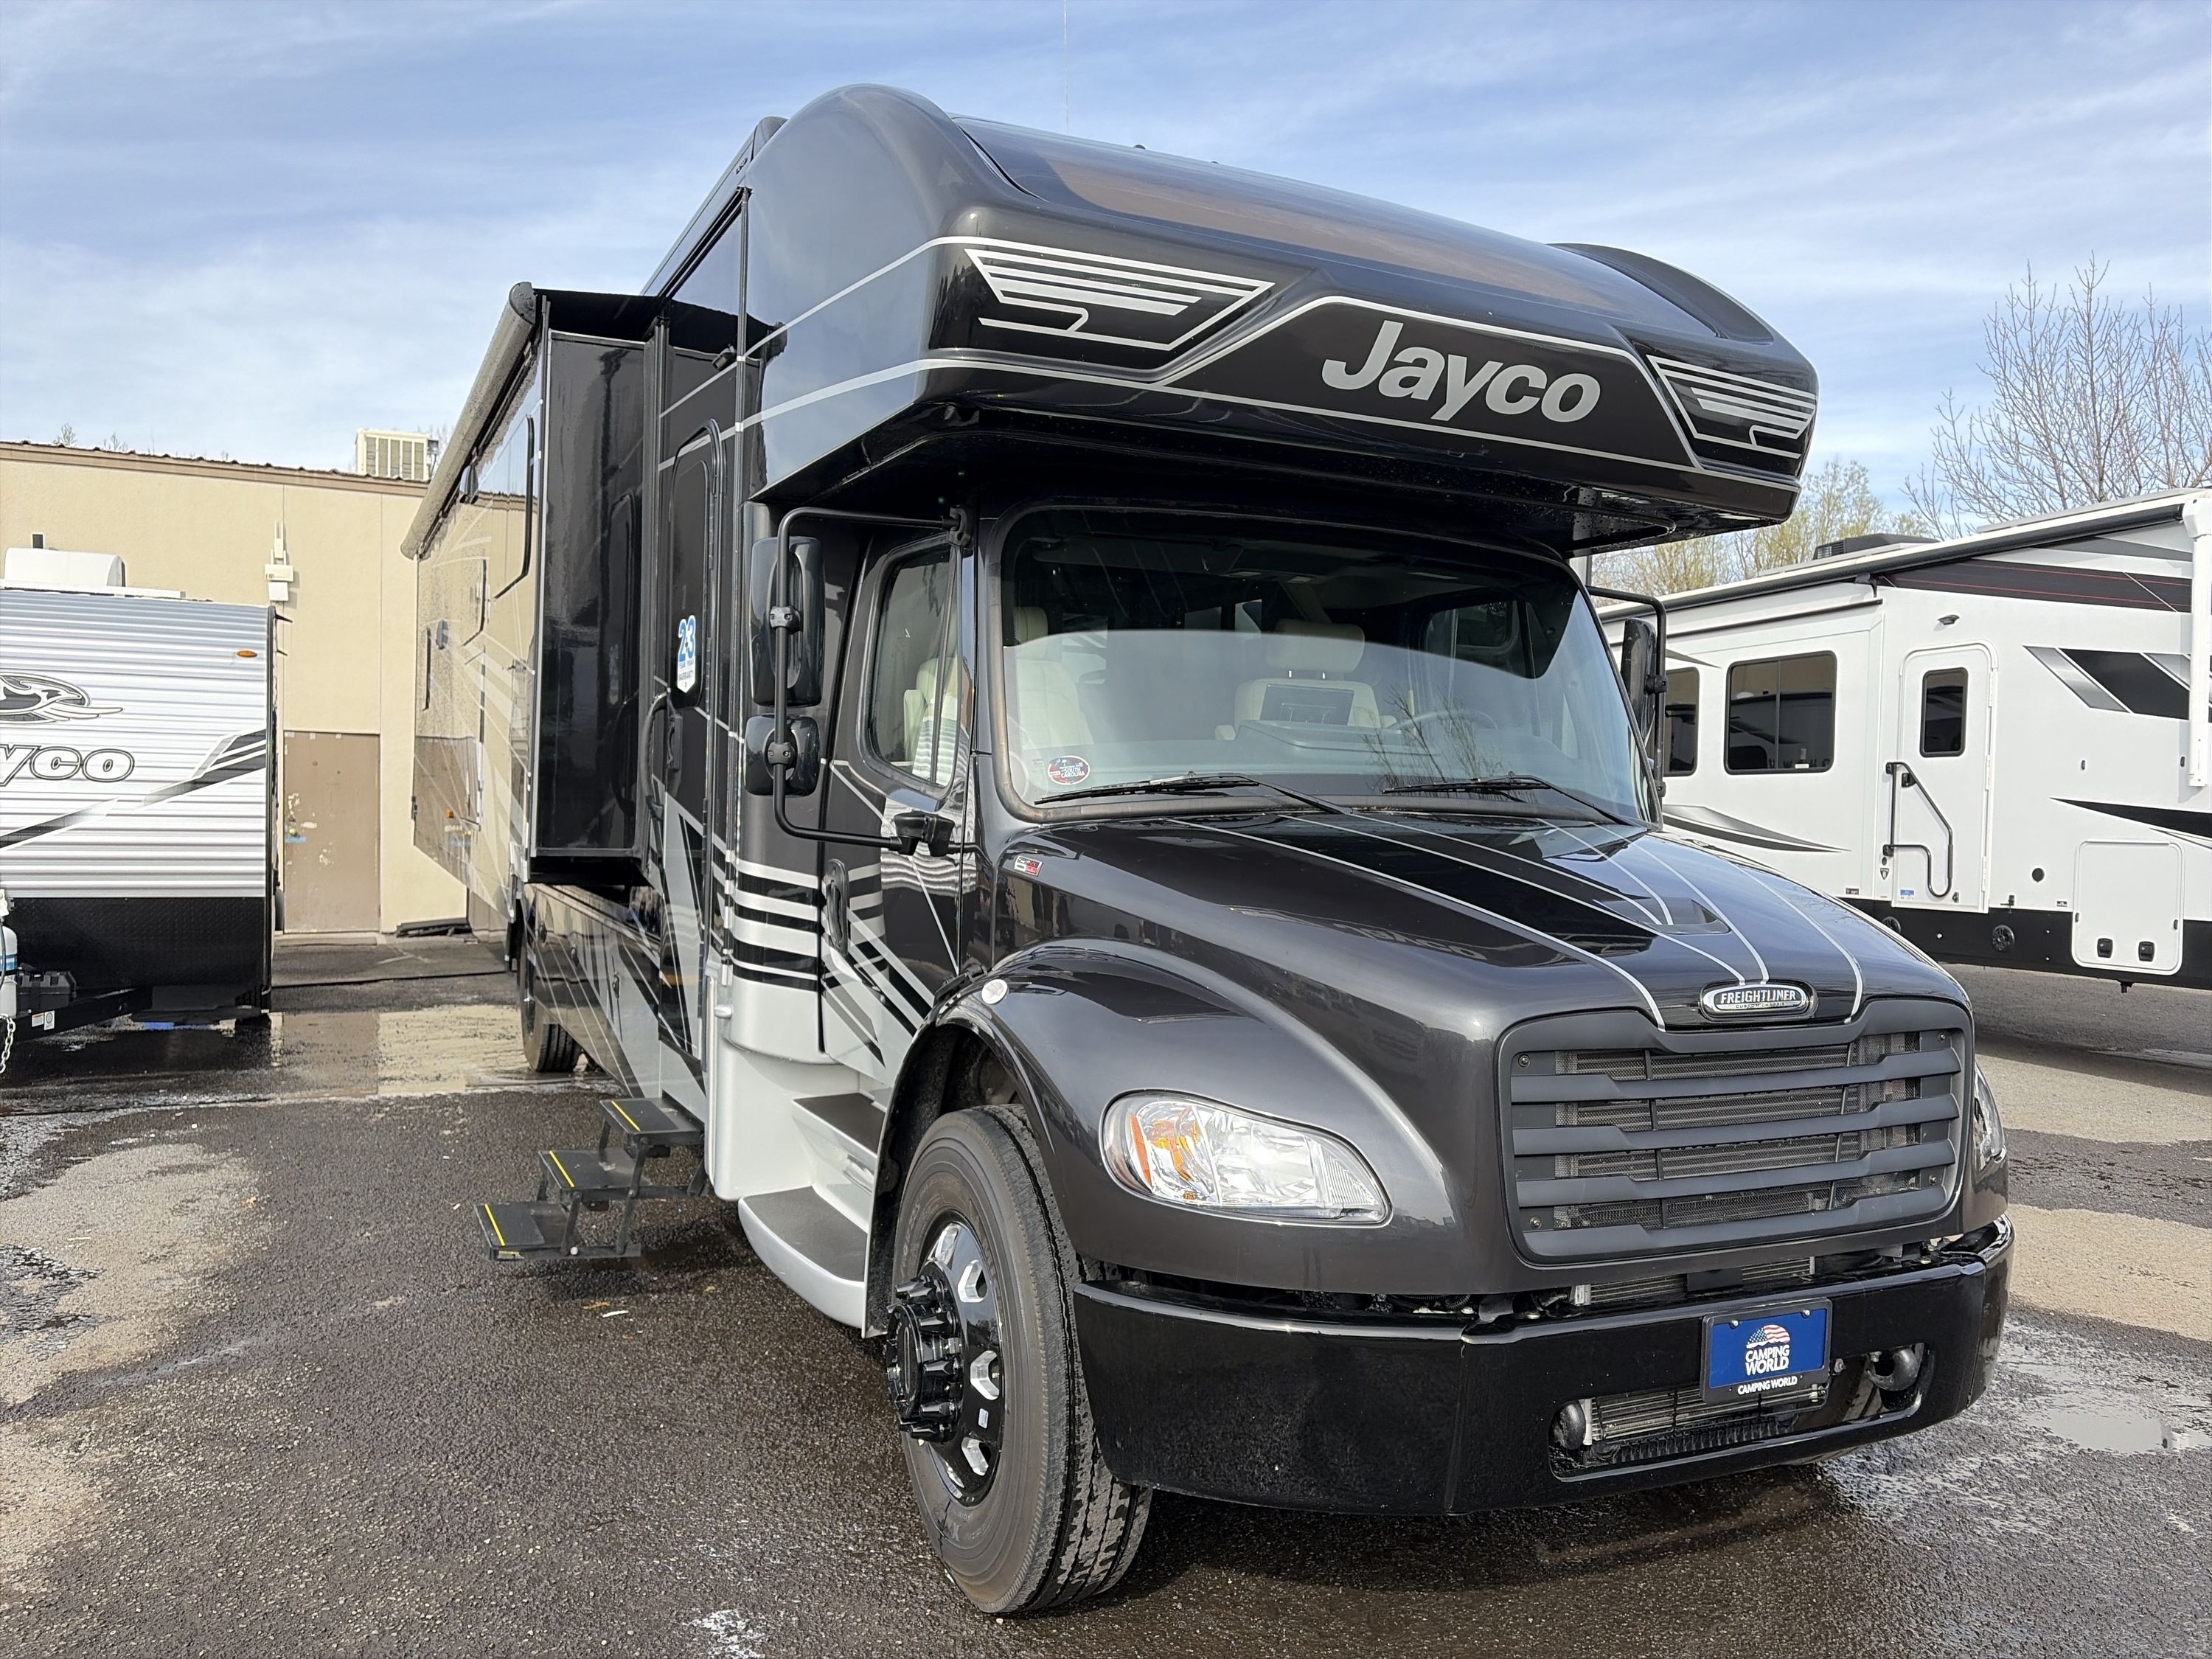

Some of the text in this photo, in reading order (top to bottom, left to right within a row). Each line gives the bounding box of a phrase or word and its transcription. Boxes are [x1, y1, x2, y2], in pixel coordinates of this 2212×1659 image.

[1321, 319, 1601, 422] Jayco
[1060, 771, 1085, 779] CAROLINA
[1720, 990, 1796, 1004] FREIGHTLINER
[1745, 1344, 1790, 1363] CAMPING
[1745, 1356, 1790, 1376] WORLD
[1737, 1375, 1798, 1395] CAMPING WORLD
